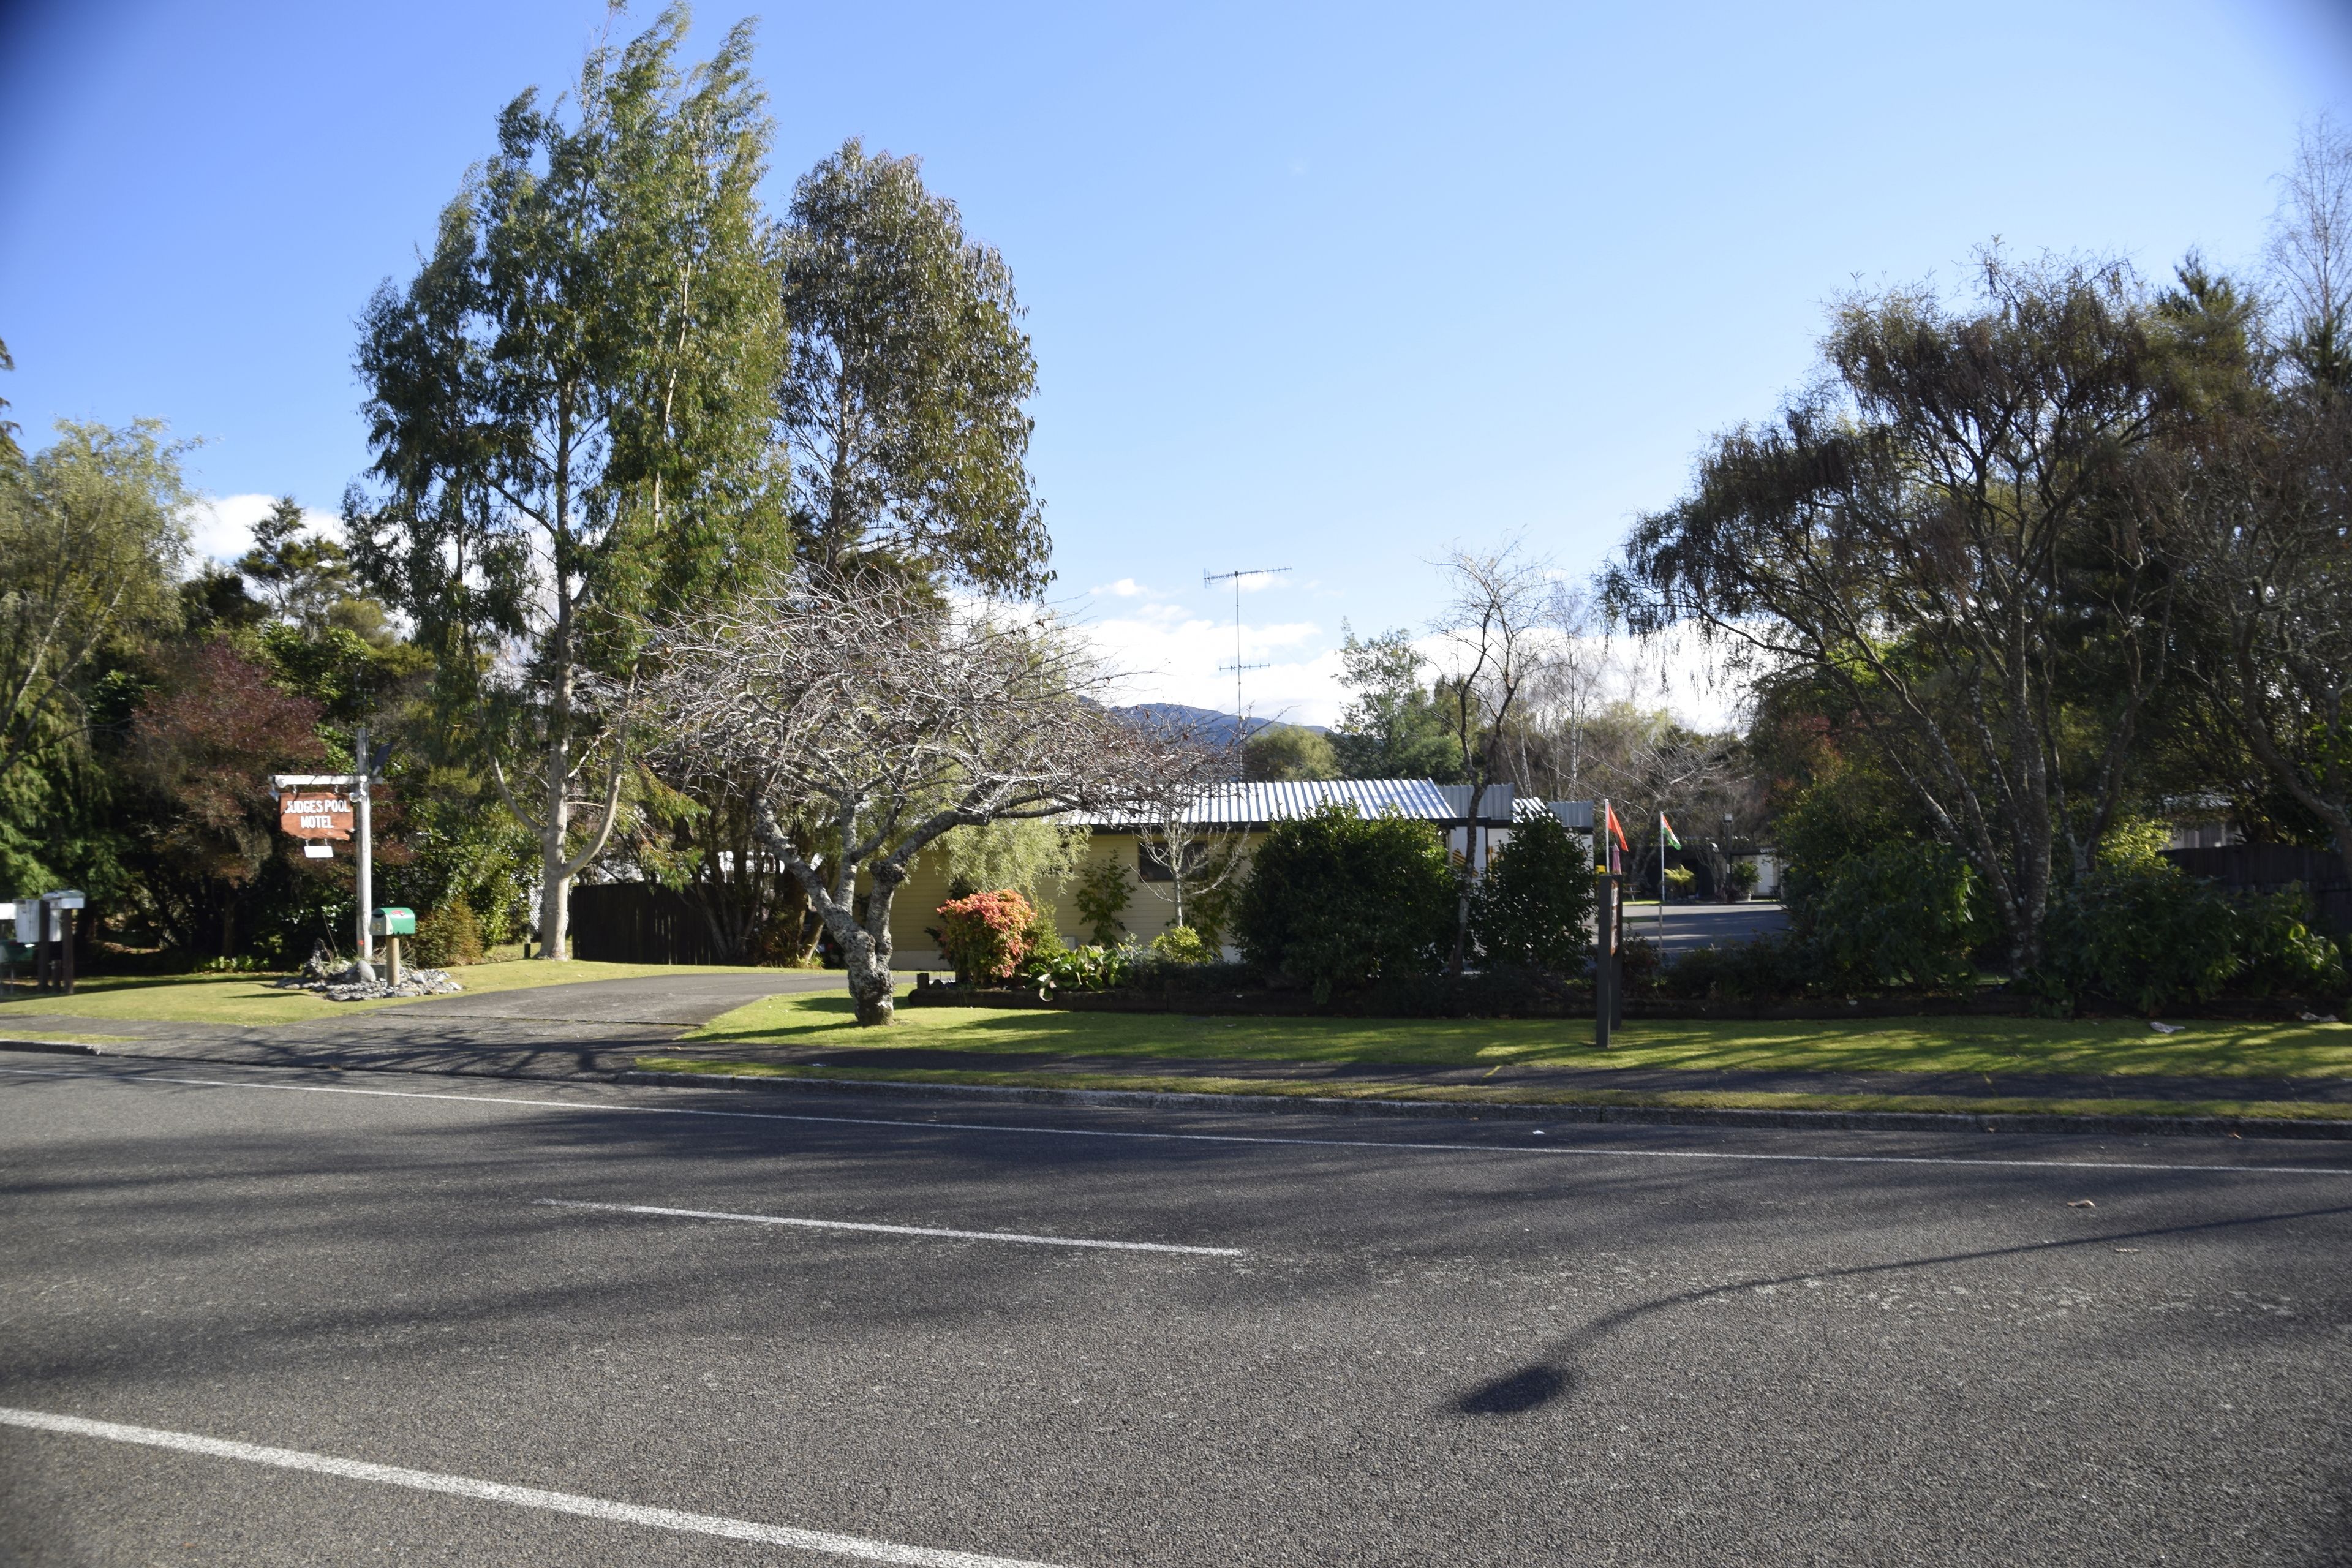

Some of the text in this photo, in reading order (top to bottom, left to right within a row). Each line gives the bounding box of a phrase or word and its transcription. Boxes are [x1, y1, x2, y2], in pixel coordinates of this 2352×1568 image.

[284, 799, 351, 813] JUDGES POOL
[300, 815, 334, 829] MOTEL
